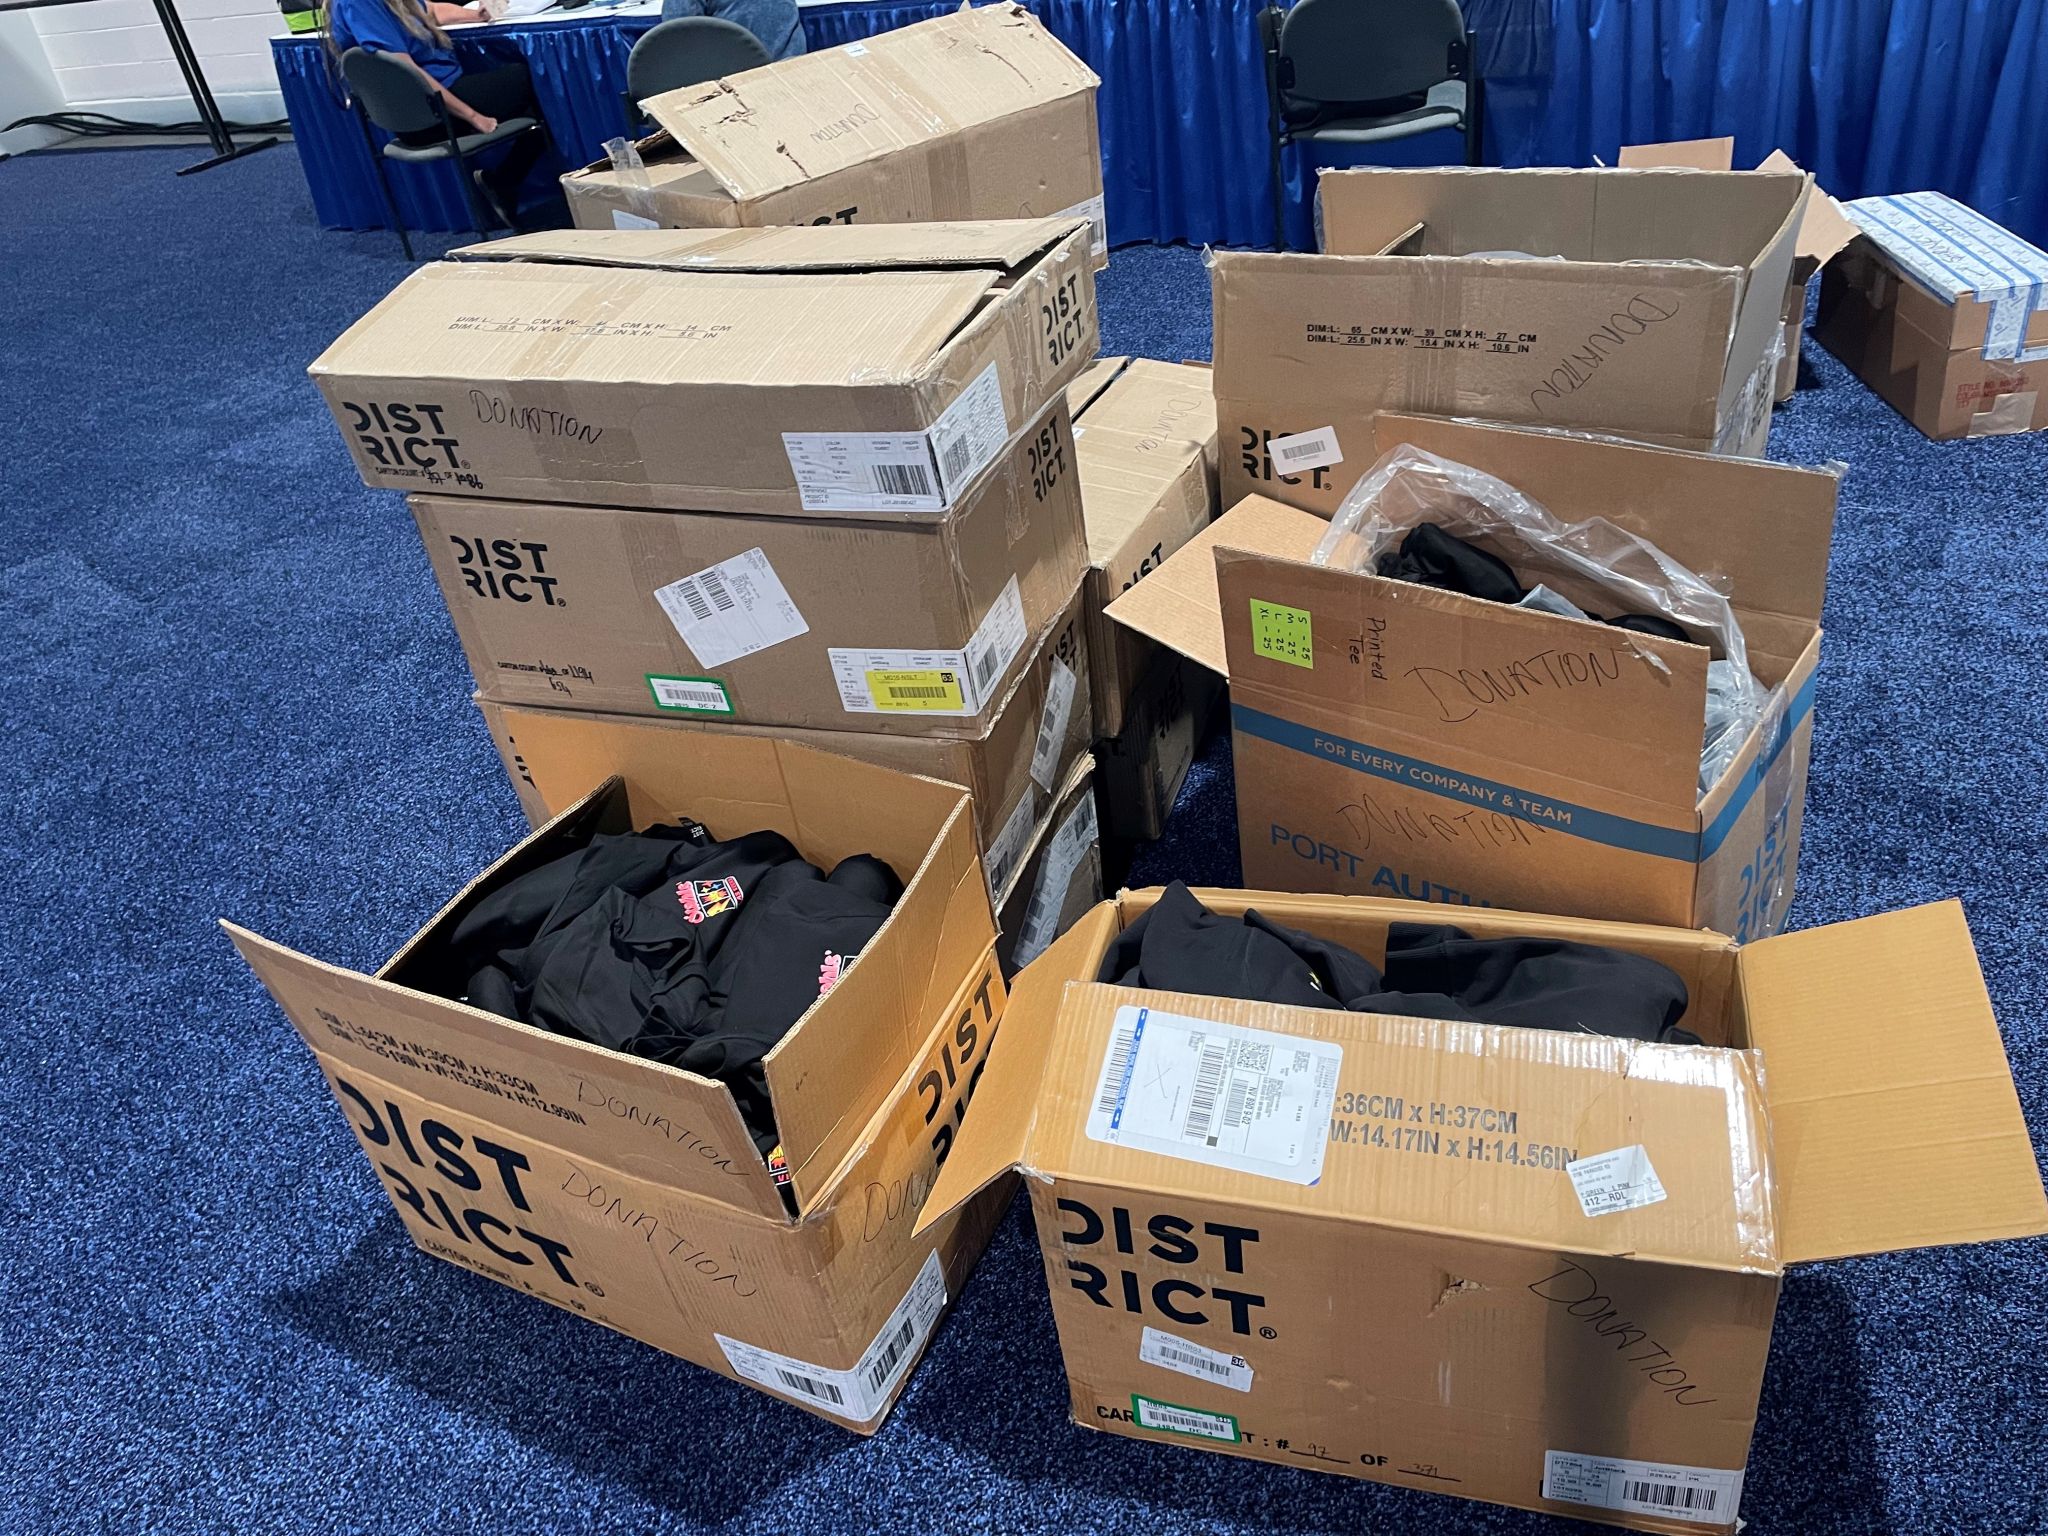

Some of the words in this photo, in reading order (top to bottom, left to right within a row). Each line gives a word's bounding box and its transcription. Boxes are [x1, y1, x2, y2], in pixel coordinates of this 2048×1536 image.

[1043, 274, 1077, 335] DIST
[1371, 327, 1388, 335] CM
[1444, 330, 1462, 339] CM
[1464, 330, 1473, 338] X
[1519, 334, 1537, 342] CM
[1371, 337, 1382, 345] IN
[1444, 340, 1455, 348] IN
[1517, 344, 1529, 353] IN
[342, 402, 444, 434] DIST
[469, 390, 603, 444] DONATION
[1028, 415, 1058, 474] DIST
[449, 535, 548, 574] DIST
[1260, 607, 1269, 620] XL
[1264, 637, 1272, 651] 25
[1276, 638, 1285, 652] 25
[1287, 641, 1296, 657] 25
[1302, 647, 1311, 661] 25
[1349, 634, 1365, 664] Tee
[1366, 617, 1389, 681] Printed
[1404, 648, 1624, 723] DONATION
[1314, 738, 1347, 757] FOR
[1351, 750, 1404, 774] EVERY
[1409, 767, 1498, 802] COMPANY
[1502, 794, 1513, 807] &
[1519, 799, 1572, 825] TEAM
[1270, 824, 1364, 877] PORT
[918, 969, 994, 1126] DIST
[1247, 1086, 1257, 1095] NV
[335, 1076, 533, 1213] DIST
[568, 1074, 750, 1178] DONATION
[1330, 1118, 1439, 1155] W:14.17IN
[1446, 1138, 1461, 1158] x
[1467, 1135, 1578, 1172] H:14.56IN
[1409, 1104, 1422, 1123] x
[1430, 1102, 1517, 1134] H:37CM
[561, 1159, 756, 1297] DONATION
[1057, 1197, 1260, 1275] DIST
[1527, 1257, 1716, 1407] DONATION
[1097, 1405, 1136, 1423] CAR
[1276, 1438, 1290, 1450] #
[1360, 1453, 1389, 1466] OF
